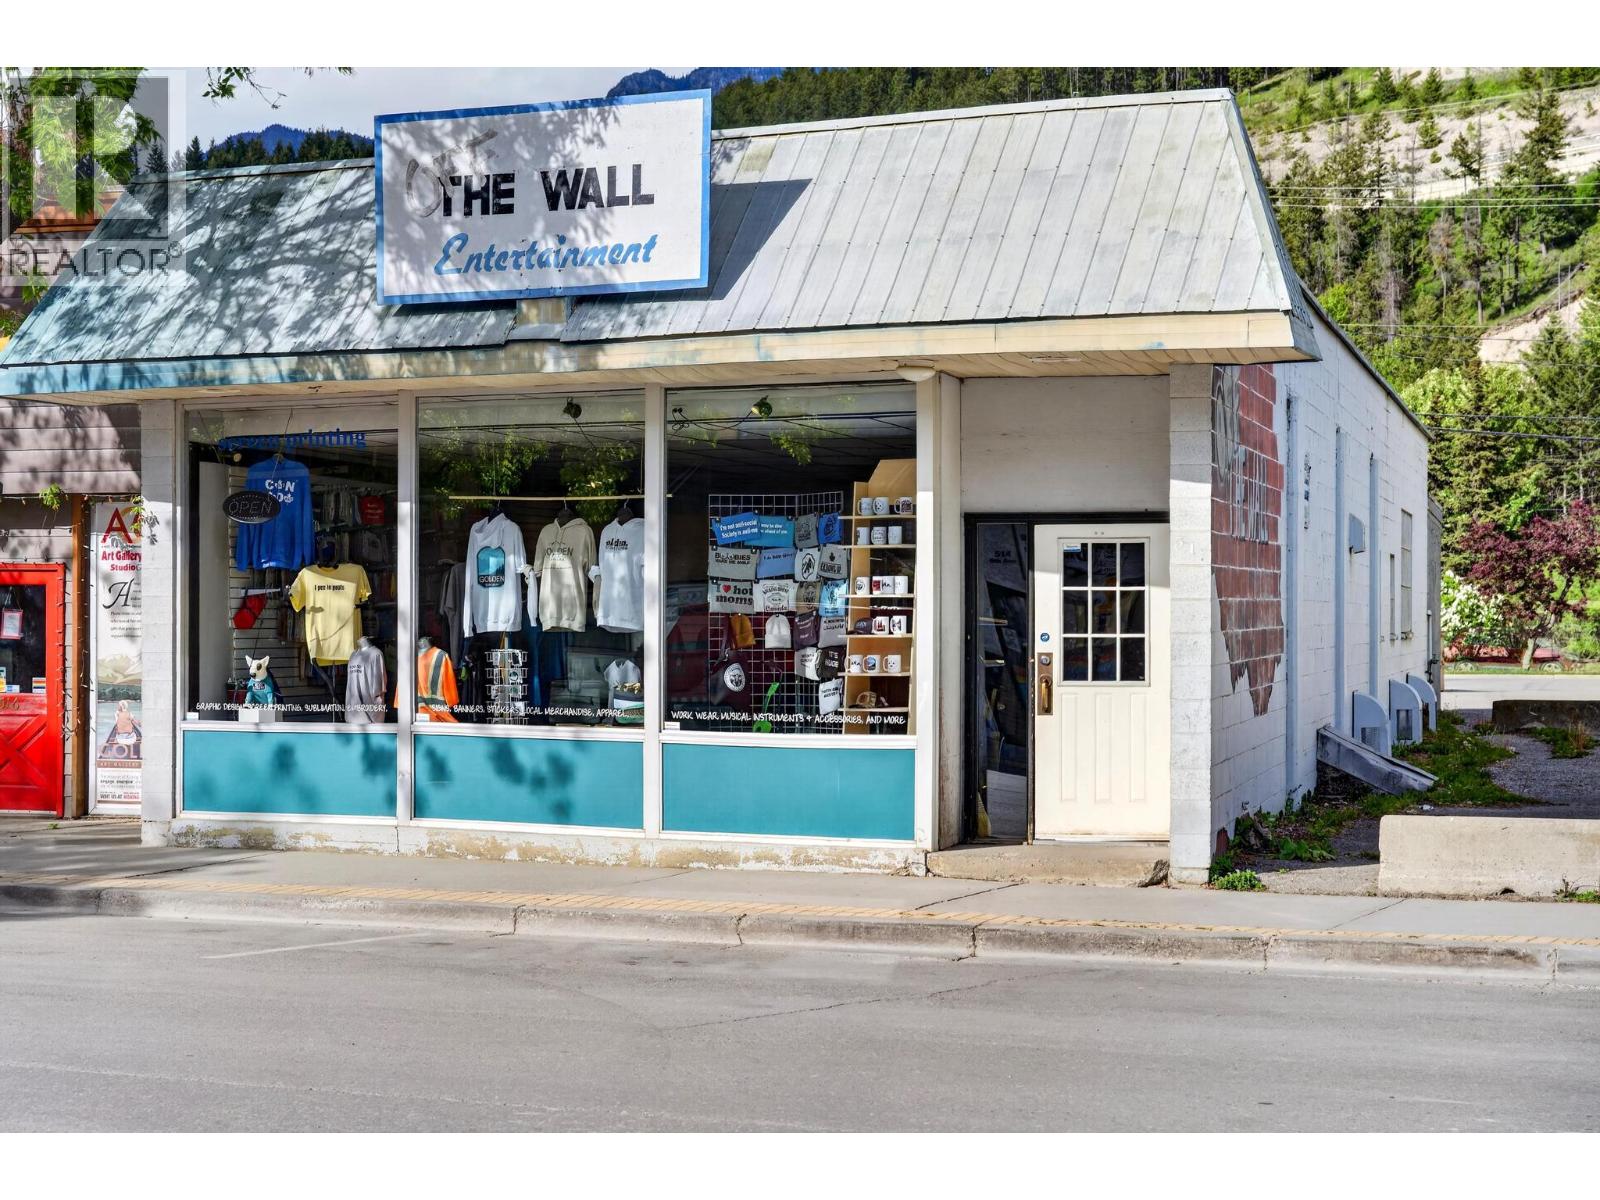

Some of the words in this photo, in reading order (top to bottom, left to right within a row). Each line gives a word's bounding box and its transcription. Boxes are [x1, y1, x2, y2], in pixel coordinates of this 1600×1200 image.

[438, 172, 516, 217] THE
[540, 164, 655, 211] WALL
[433, 233, 659, 276] Entertainment
[228, 501, 274, 517] OPEN
[101, 551, 114, 561] Art
[115, 550, 142, 562] Gallery
[716, 594, 753, 606] moms
[196, 702, 222, 711] GRAPHIC
[521, 706, 543, 716] LOCAL
[671, 710, 693, 719] WORK
[720, 712, 751, 721] MUSICAL
[753, 713, 804, 723] INSTRUMENTS
[866, 715, 882, 725] AND
[883, 716, 906, 725] MORE
